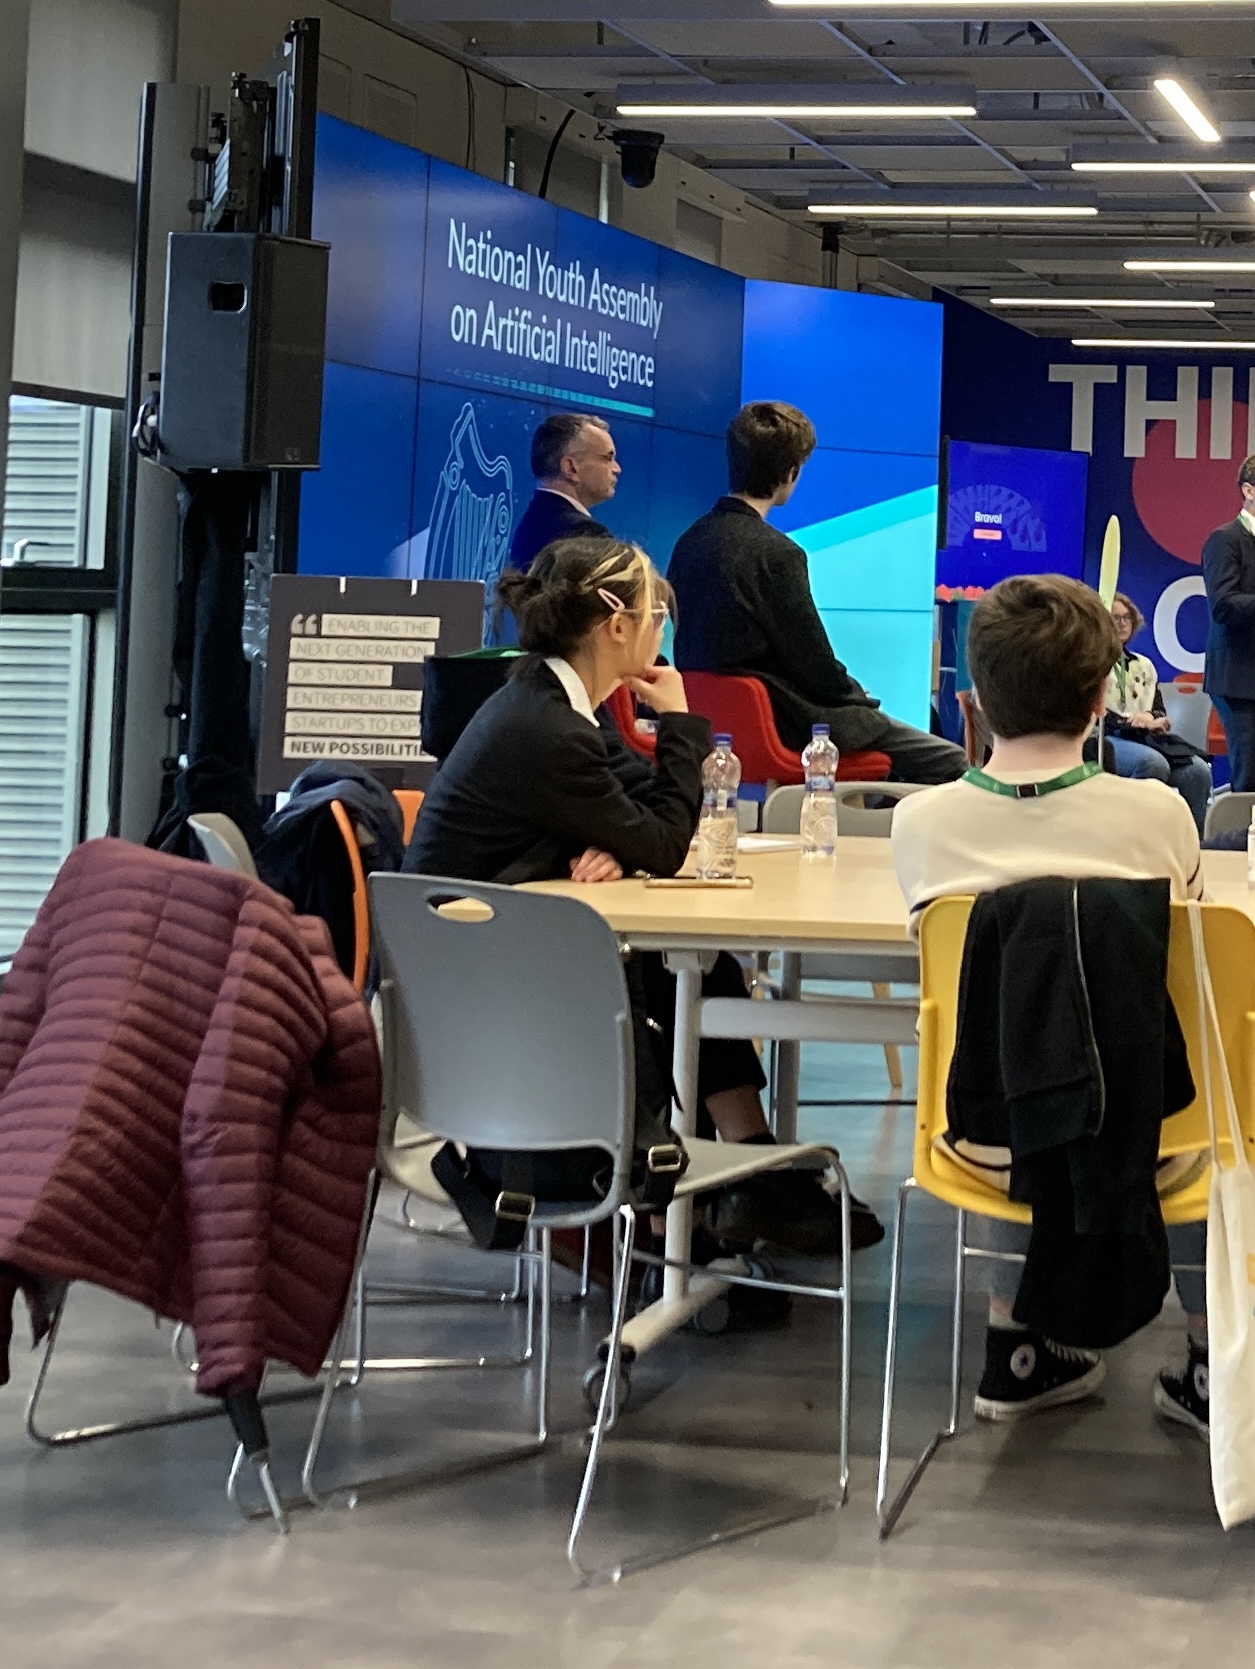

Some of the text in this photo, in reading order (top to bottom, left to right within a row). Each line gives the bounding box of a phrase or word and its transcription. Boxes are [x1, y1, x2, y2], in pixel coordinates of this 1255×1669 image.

[448, 218, 663, 339] National Youth Assembly
[451, 300, 655, 389] on Artificial Intelligence
[974, 511, 1002, 524] Bravo!
[328, 619, 431, 634] ENABLING THE
[296, 642, 428, 659] NEXT GENERATION
[294, 667, 385, 682] OF STUDENT
[293, 691, 418, 708] ENTREPRENEURS
[292, 716, 418, 733] STARTUPS TO EXP
[291, 740, 325, 754] NEW
